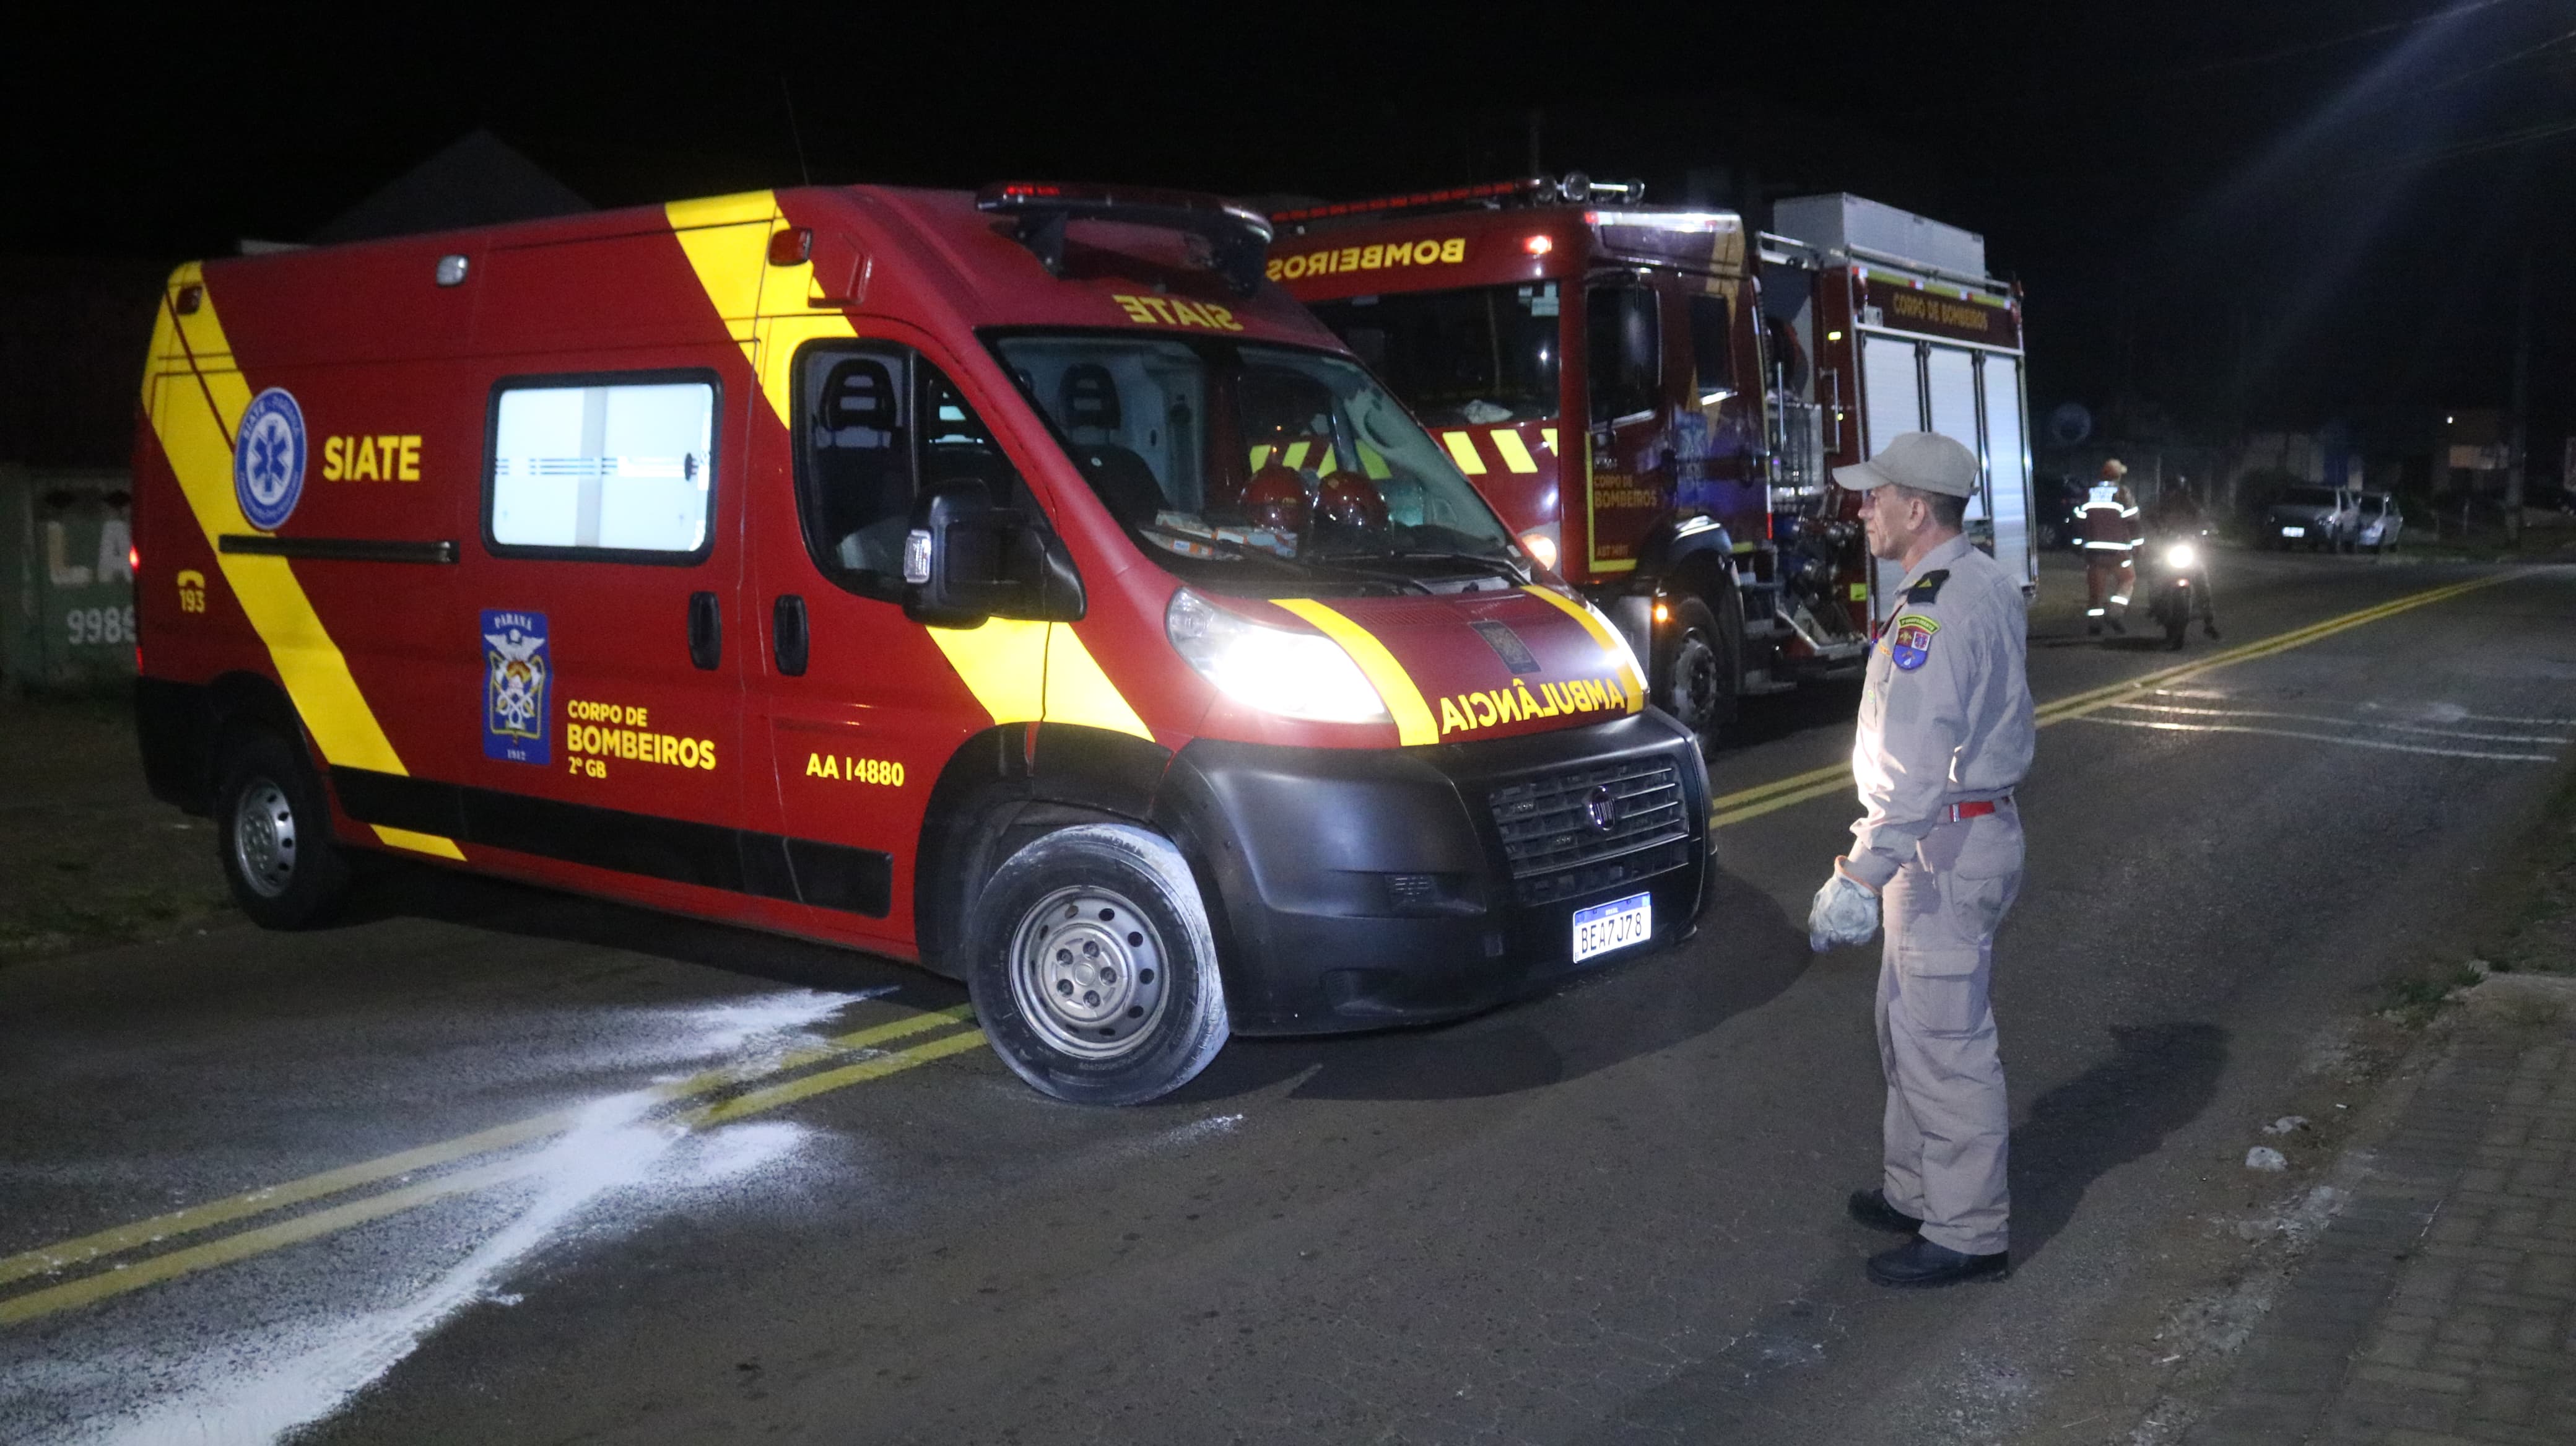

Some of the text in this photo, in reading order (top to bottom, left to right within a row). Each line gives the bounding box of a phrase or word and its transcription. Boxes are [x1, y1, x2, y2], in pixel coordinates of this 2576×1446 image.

[1893, 291, 1988, 331] CORPO DE BOMBEIROS
[323, 435, 422, 481] SIATE
[1594, 474, 1621, 489] CORPO
[1594, 489, 1657, 509] BOMBEIROS
[179, 588, 205, 613] 193
[567, 699, 648, 727] CORPO DE
[567, 723, 716, 770] BOMBEIROS
[585, 759, 607, 778] GB
[806, 752, 905, 787] AA 14880
[1582, 912, 1642, 954] BEA7J78
